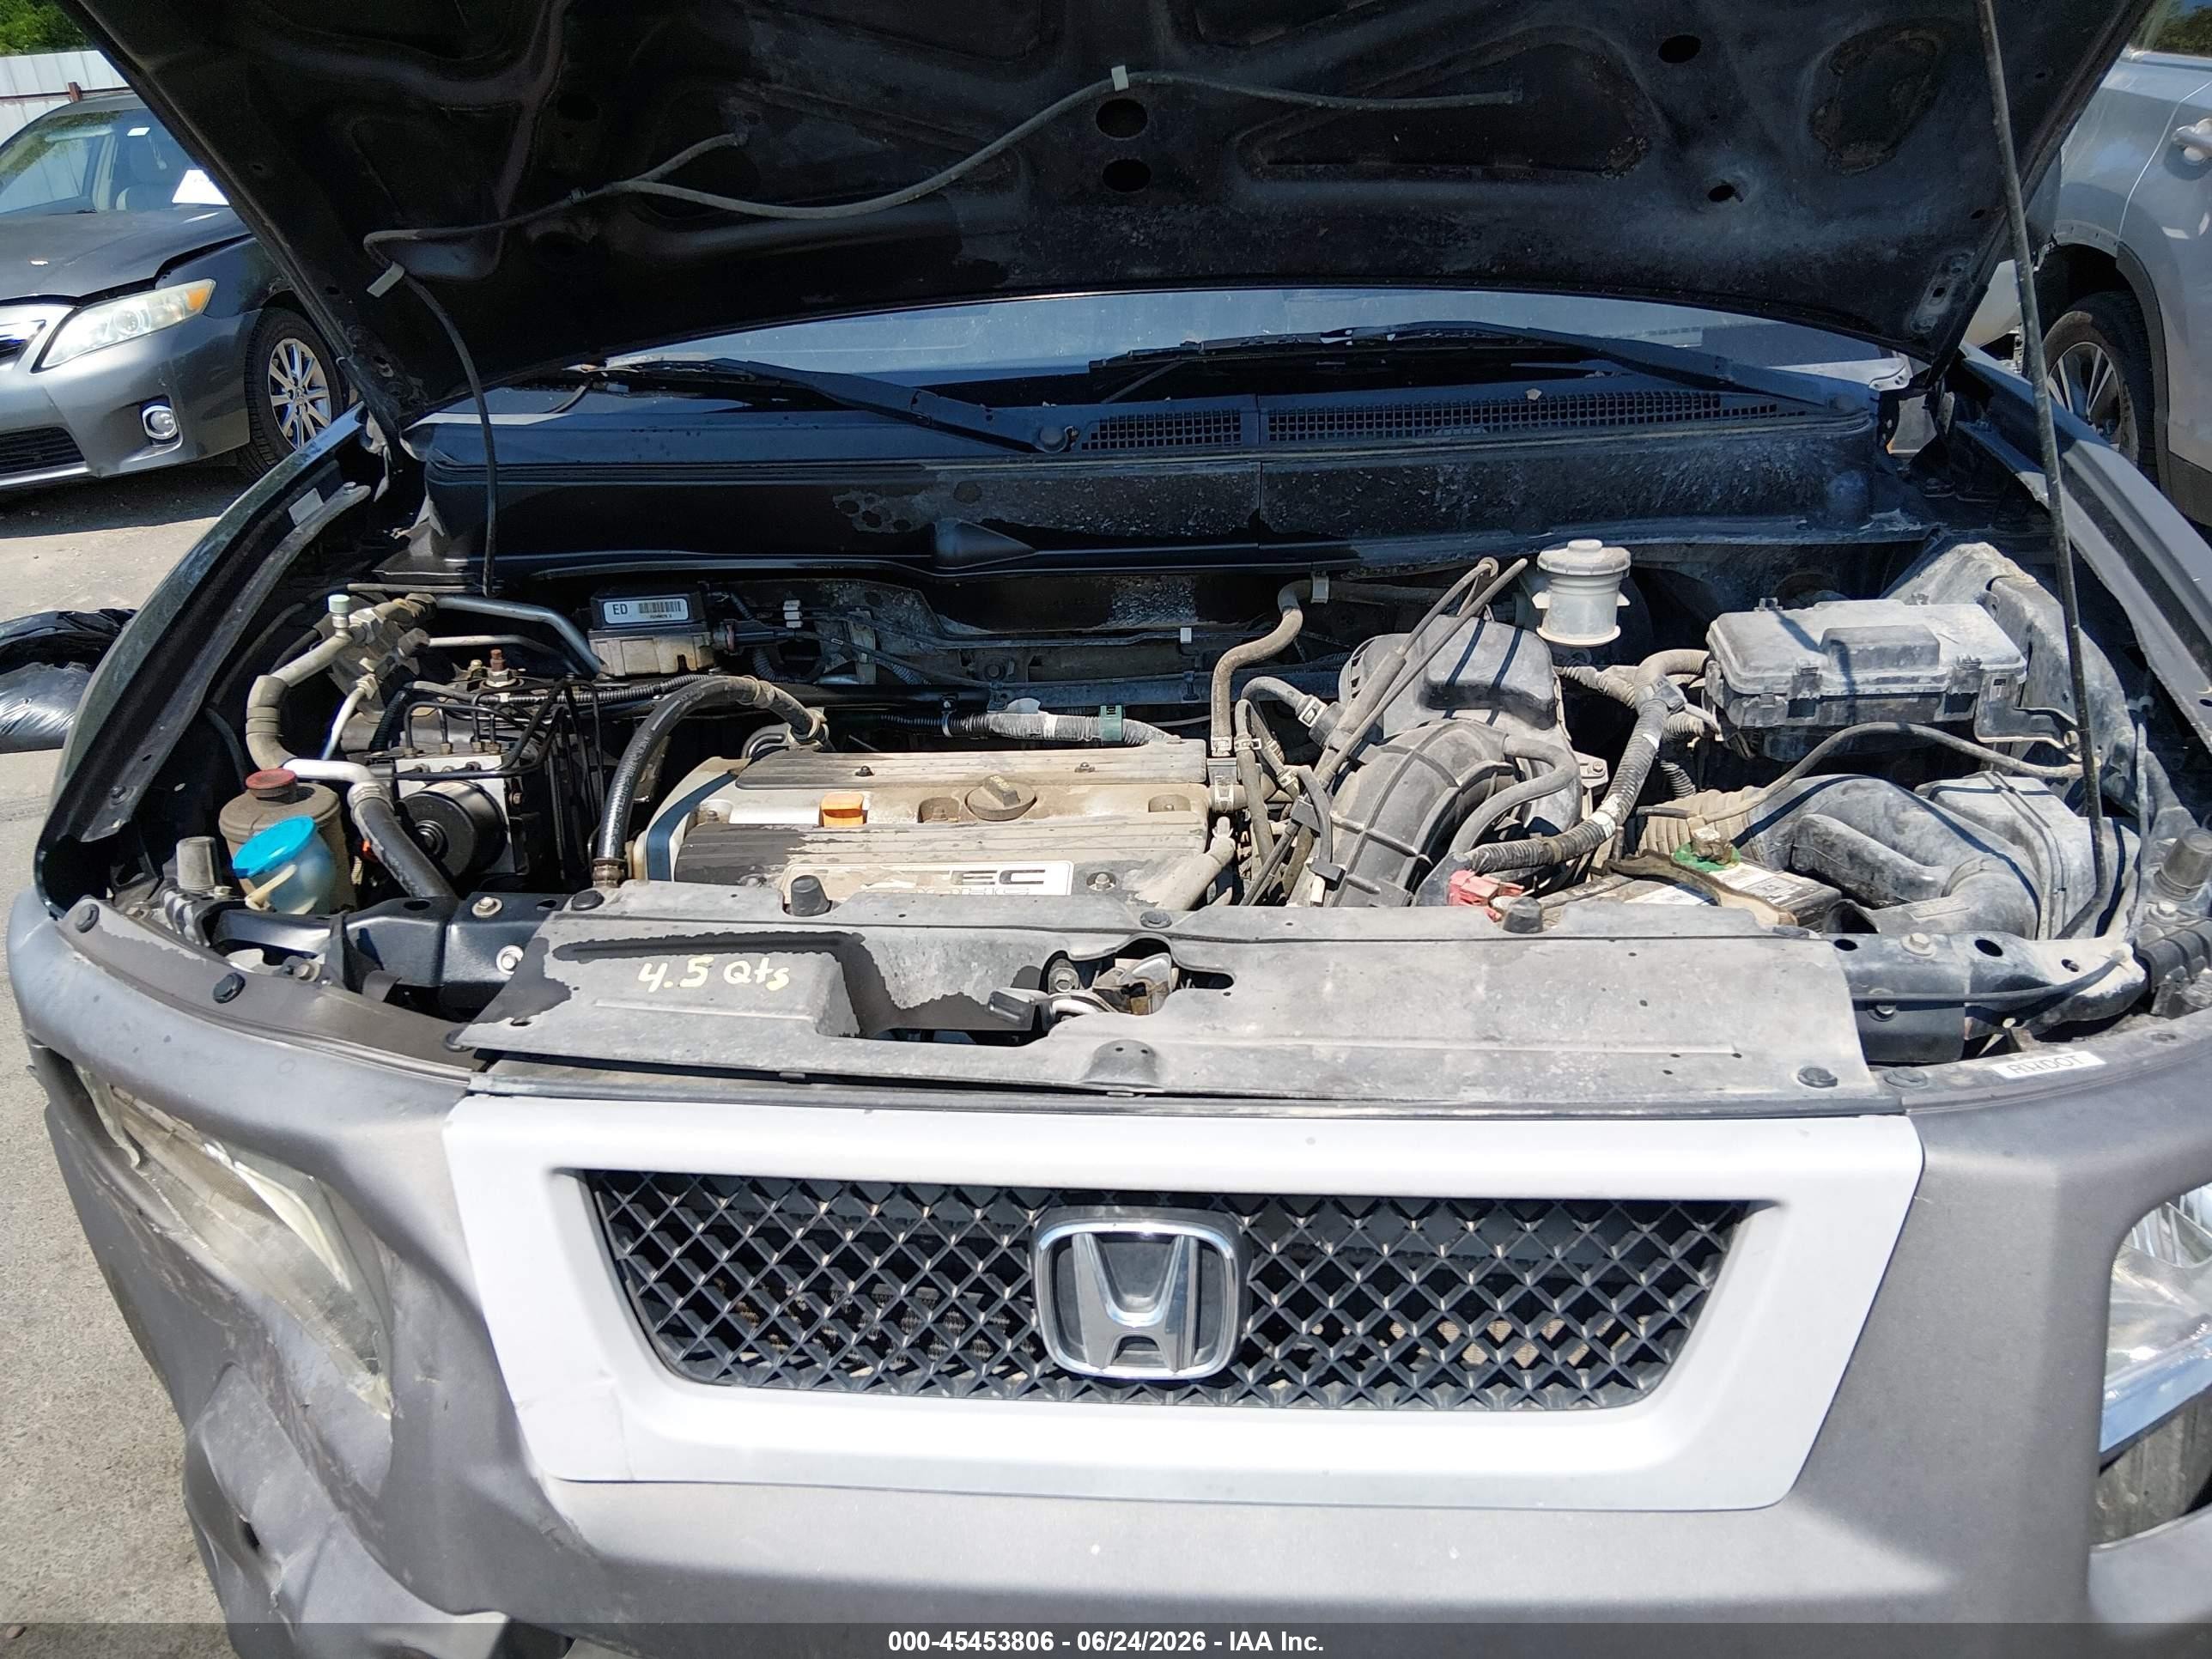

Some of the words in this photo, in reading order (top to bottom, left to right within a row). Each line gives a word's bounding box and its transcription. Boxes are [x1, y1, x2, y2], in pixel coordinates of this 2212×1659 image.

[612, 604, 628, 615] ED
[638, 956, 714, 993] 4.5
[723, 957, 790, 991] Qts
